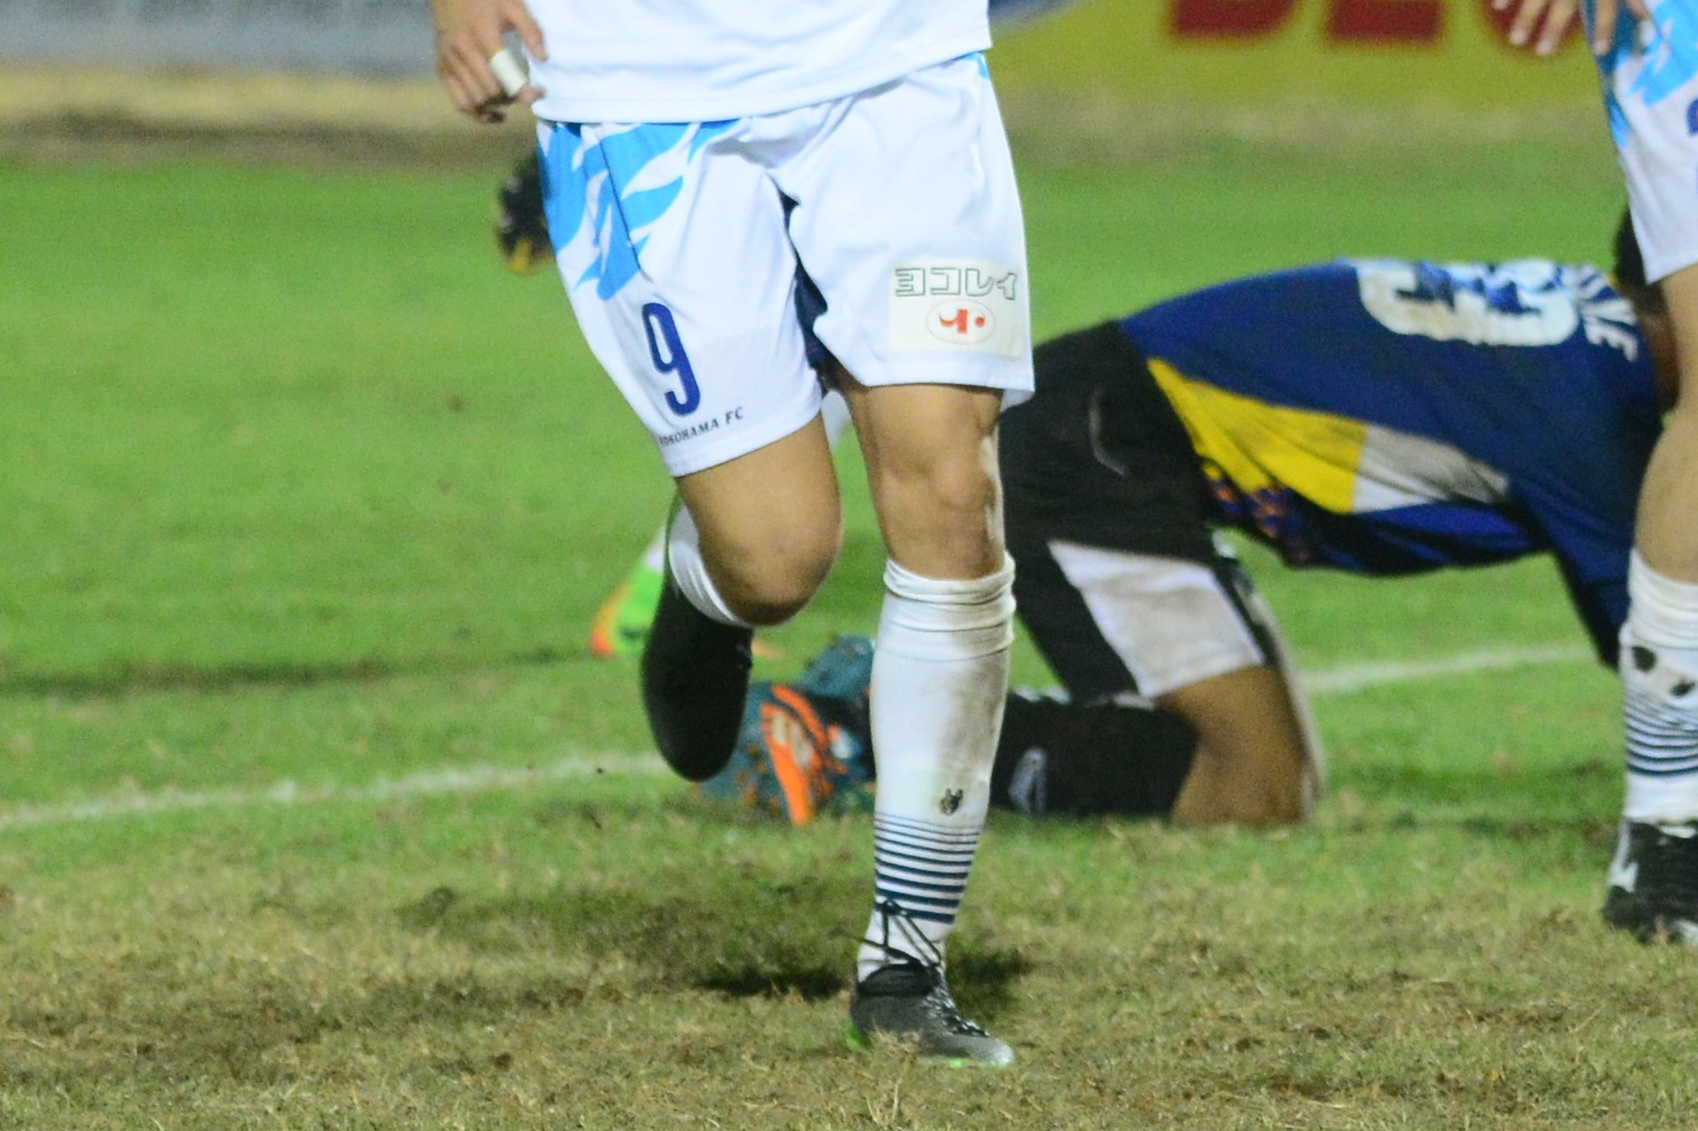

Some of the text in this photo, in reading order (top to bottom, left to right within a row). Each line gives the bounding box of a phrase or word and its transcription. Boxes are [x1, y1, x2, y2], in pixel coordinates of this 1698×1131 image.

[895, 267, 1018, 301] ヨコレイ
[641, 302, 701, 417] 9
[658, 406, 745, 448] YOKOHAMA FC
